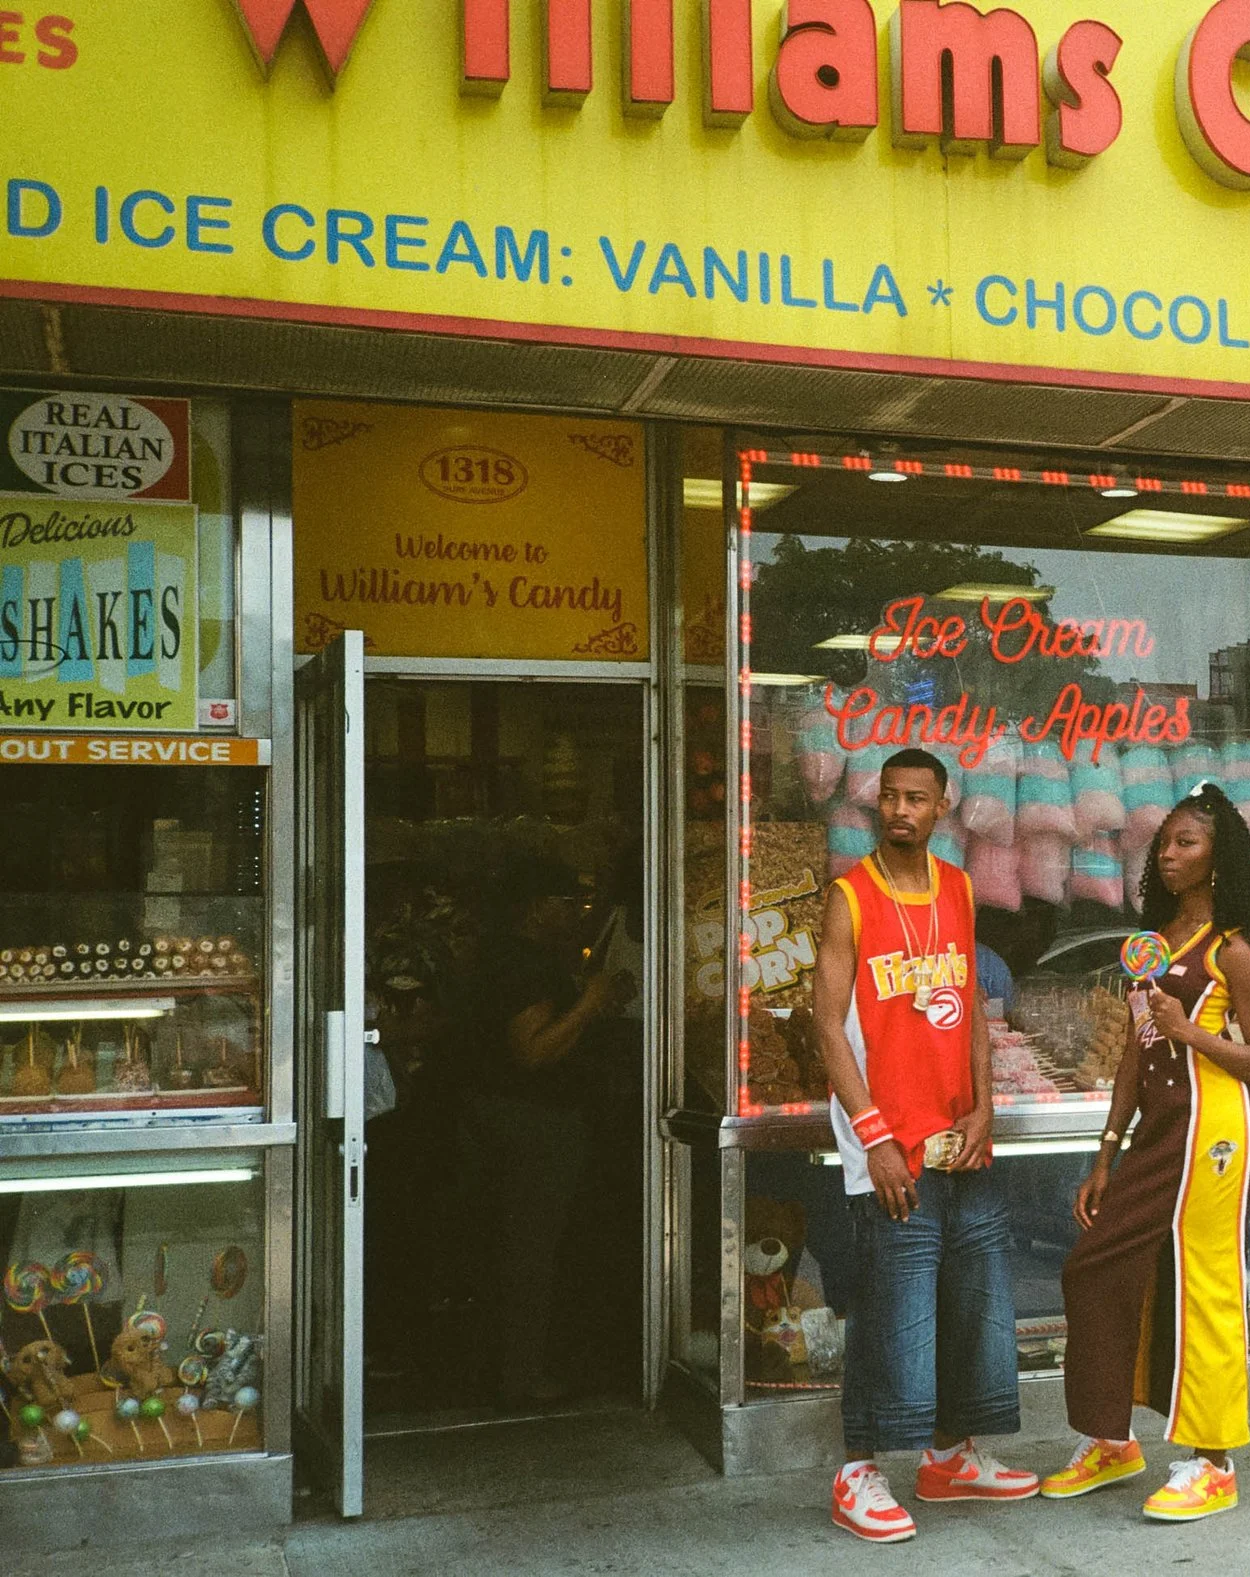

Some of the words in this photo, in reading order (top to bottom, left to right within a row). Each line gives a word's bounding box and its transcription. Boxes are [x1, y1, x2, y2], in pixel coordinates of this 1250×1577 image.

[232, 0, 1122, 162] iams
[7, 178, 62, 237] D
[94, 186, 233, 254] ICE
[262, 203, 573, 287] CREAM:
[599, 235, 907, 317] VANILLA
[45, 401, 142, 431] REAL
[20, 429, 165, 462] ITALIAN
[43, 461, 143, 490] ICES
[436, 456, 515, 486] 1318
[0, 510, 137, 549] Delicious
[395, 532, 519, 563] Welcome
[524, 540, 549, 564] to
[319, 566, 499, 609] William's
[509, 575, 624, 624] Candy
[1, 585, 181, 662] SHAKES
[869, 596, 969, 664] Ice
[981, 595, 1156, 664] Cream
[68, 692, 171, 719] Flavor
[825, 682, 1005, 770] Candy
[1020, 683, 1192, 768] Apples
[0, 739, 75, 761] OUT
[88, 740, 231, 762] SERVICE
